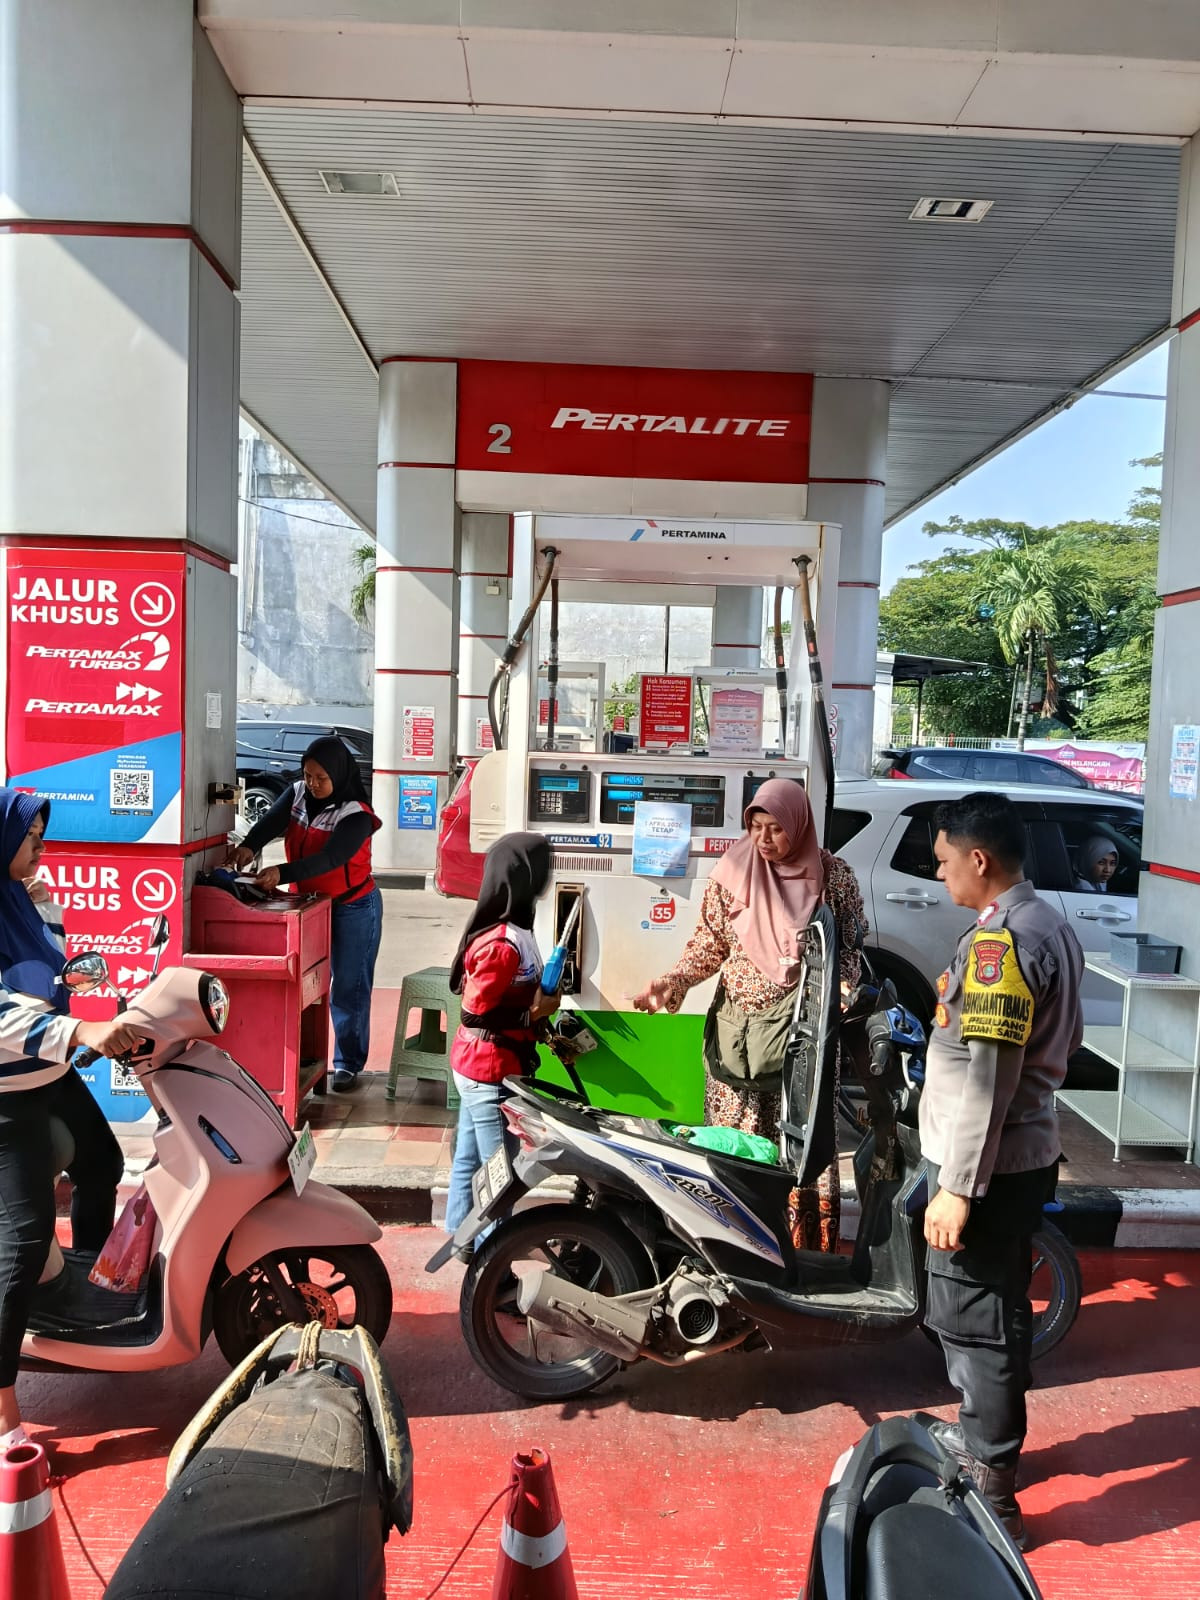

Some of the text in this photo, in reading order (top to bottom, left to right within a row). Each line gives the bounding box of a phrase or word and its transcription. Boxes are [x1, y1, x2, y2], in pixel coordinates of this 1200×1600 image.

[550, 407, 791, 437] PERTALITE
[487, 423, 512, 454] 2
[661, 529, 727, 541] PERTAMINA
[12, 577, 119, 603] JALUR
[11, 604, 120, 626] KHUSUS
[26, 645, 144, 661] PERTAMAX
[68, 659, 142, 671] TURBO
[25, 698, 163, 716] PERTAMAX
[550, 833, 610, 848] PERTAMAX 92
[34, 864, 121, 889] ALUR
[48, 892, 121, 911] USUS
[66, 934, 144, 945] TAMAX
[71, 944, 142, 954] TURBO
